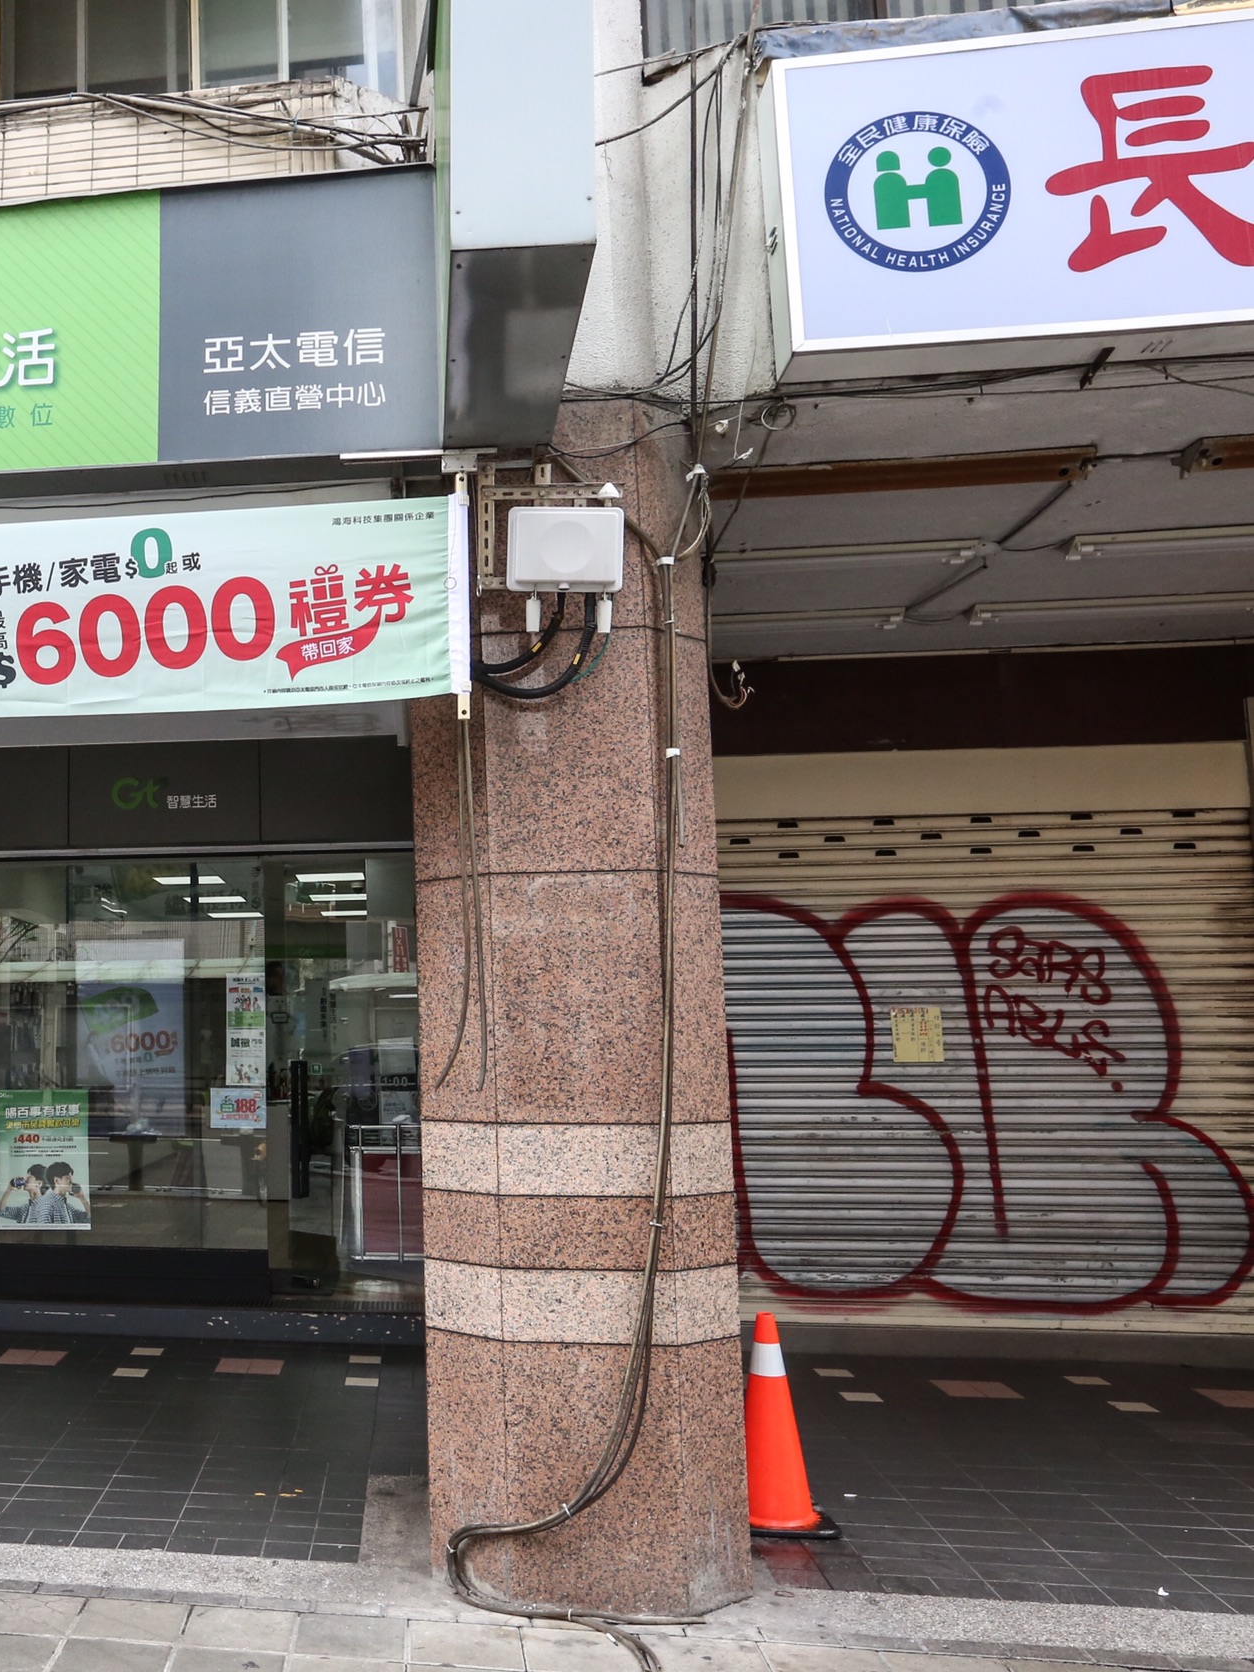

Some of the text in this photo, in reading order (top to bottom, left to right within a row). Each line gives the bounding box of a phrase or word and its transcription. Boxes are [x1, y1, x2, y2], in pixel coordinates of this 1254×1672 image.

[838, 113, 990, 167] 全民健康保險
[1045, 64, 1254, 273] 長
[830, 181, 1006, 267] NATIONAL HEALTH INSURANCE
[203, 327, 386, 374] 亞太電信
[203, 381, 386, 416] 信義直營中心
[289, 563, 415, 637] 禮券
[300, 635, 356, 662] 帶回家
[166, 793, 217, 810] 智慧生活
[13, 1134, 41, 1144] $440
